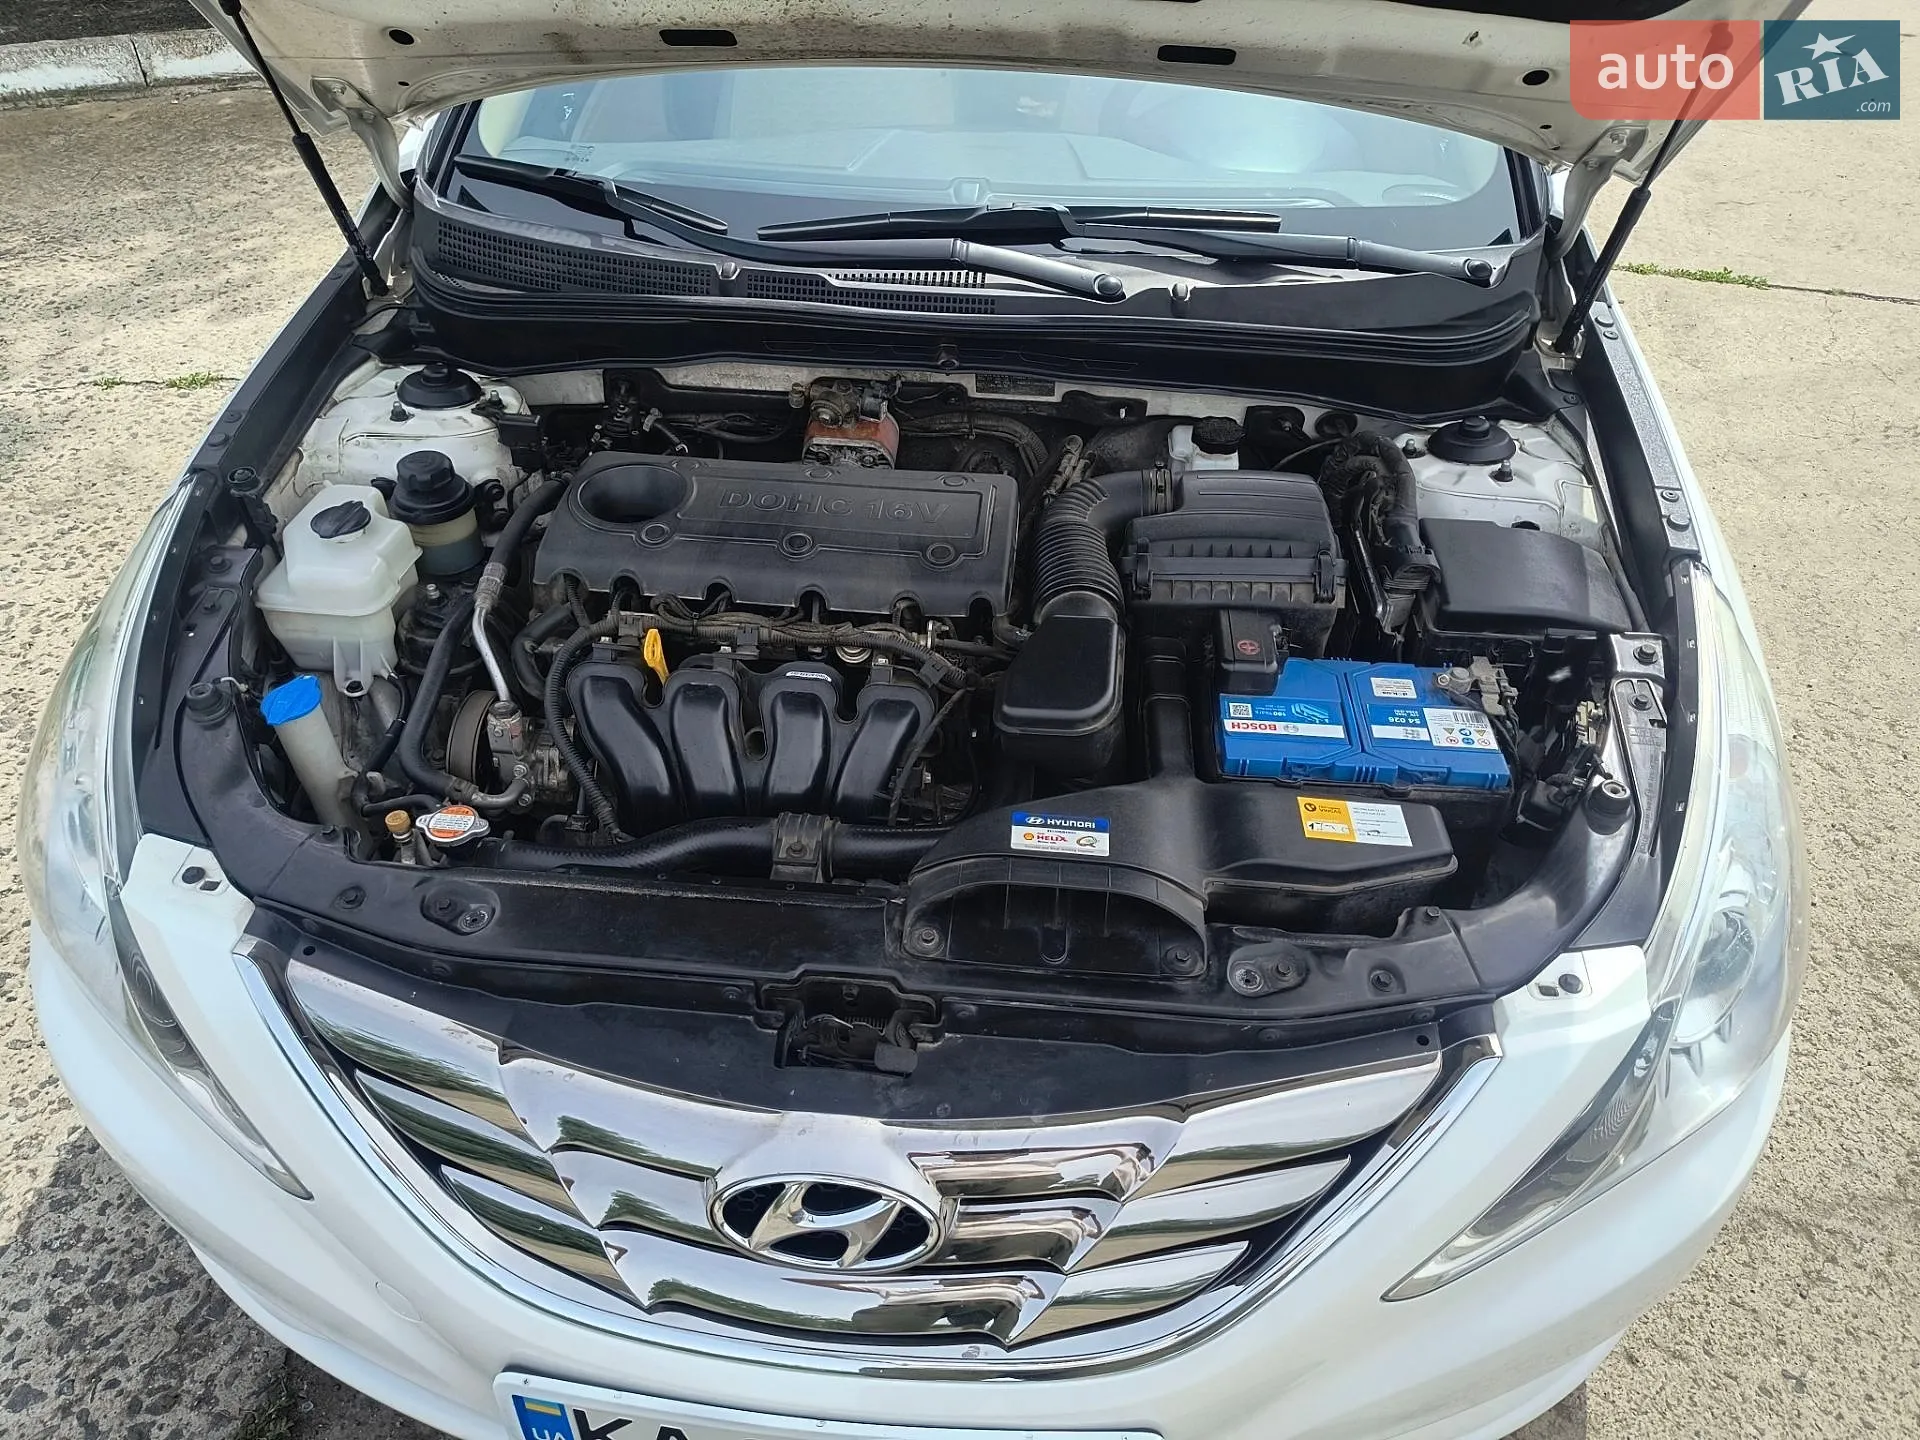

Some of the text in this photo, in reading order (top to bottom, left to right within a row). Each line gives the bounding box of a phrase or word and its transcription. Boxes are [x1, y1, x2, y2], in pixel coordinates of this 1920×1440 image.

[719, 488, 952, 524] DOHC 16V
[1231, 721, 1277, 731] BOSCH
[1047, 818, 1096, 829] HYUNDAI
[1036, 834, 1068, 843] HELIX
